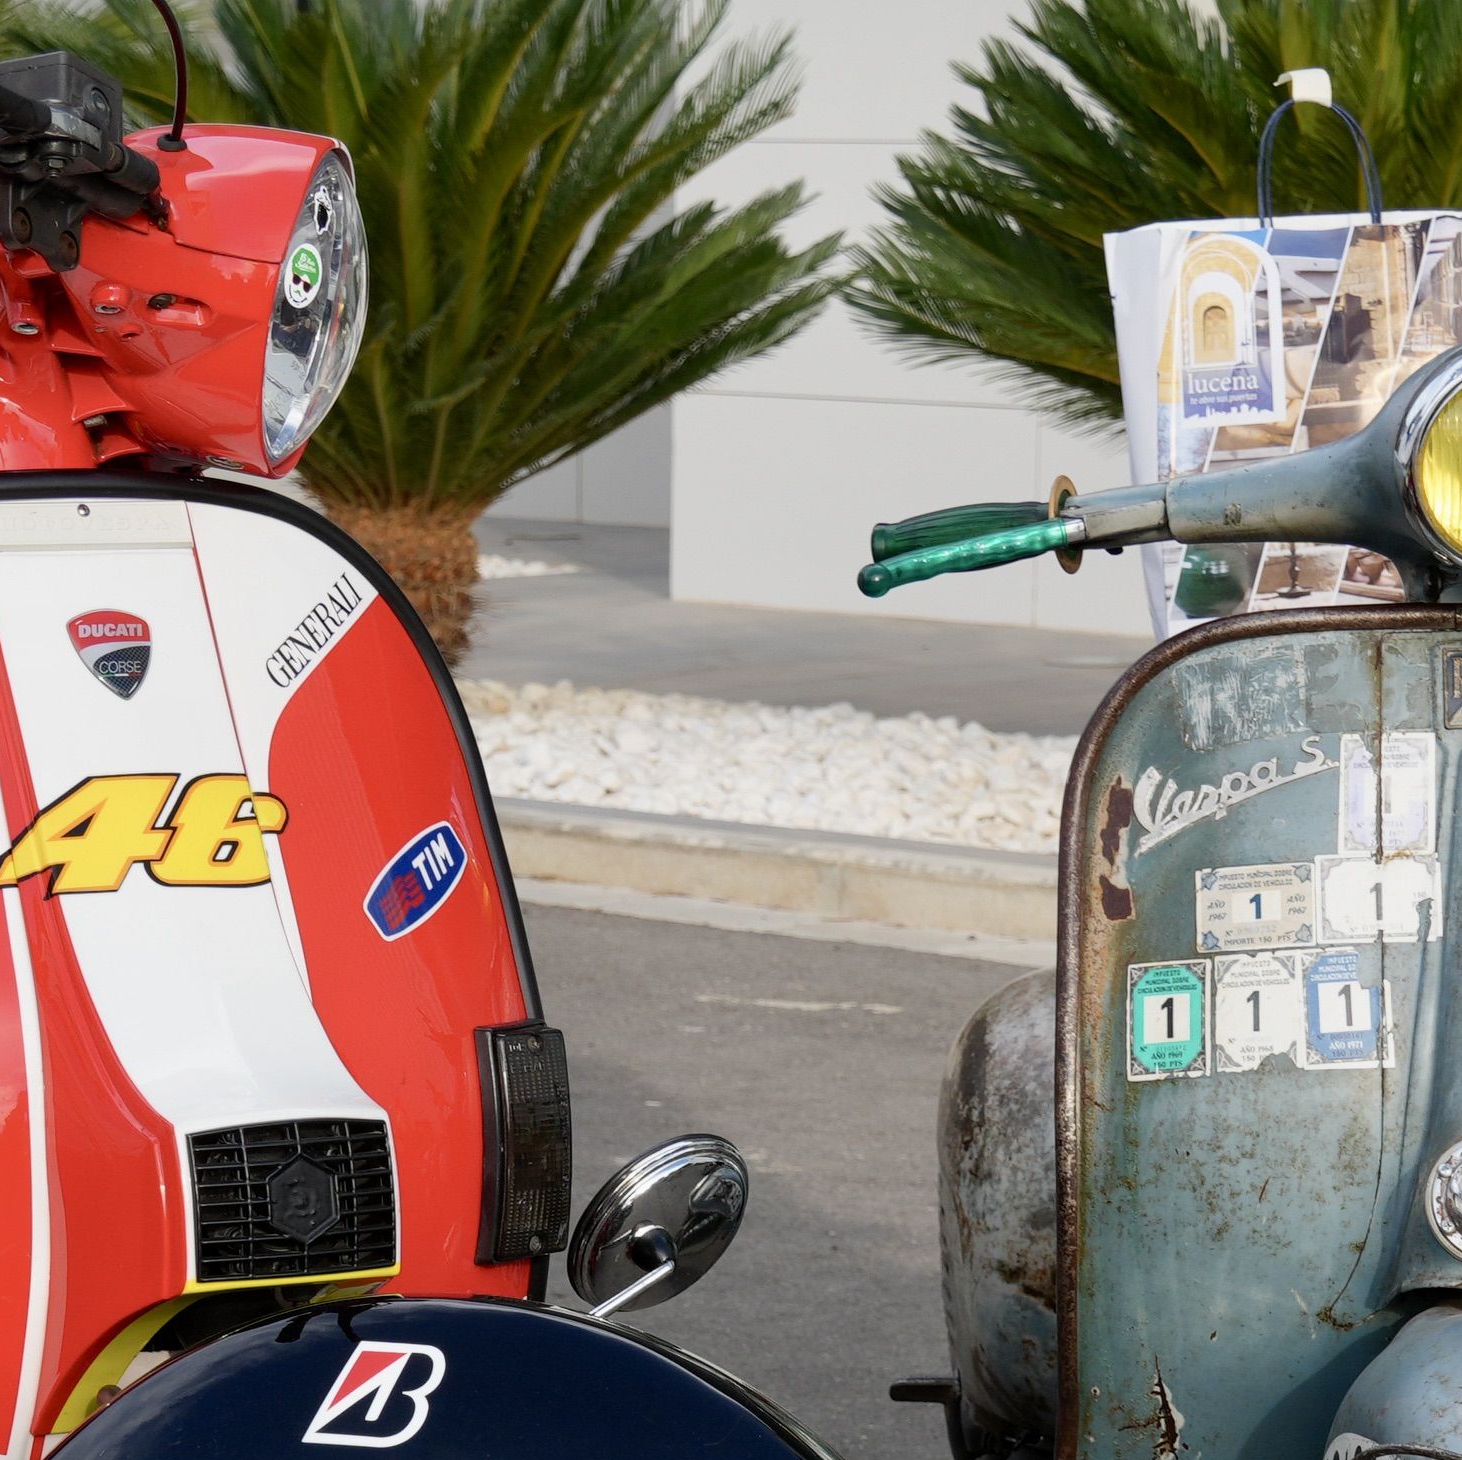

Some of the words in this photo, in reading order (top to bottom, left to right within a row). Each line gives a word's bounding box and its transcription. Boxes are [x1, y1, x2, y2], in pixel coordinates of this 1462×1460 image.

[1187, 373, 1259, 394] lucena
[77, 623, 143, 638] DUCATI
[263, 572, 363, 689] GENERALI
[99, 660, 141, 674] CORSE
[1132, 757, 1283, 855] Vespa
[411, 830, 455, 892] TIM
[1249, 893, 1262, 920] 1
[1370, 882, 1383, 921] 1
[1161, 997, 1174, 1038] 1
[1246, 990, 1260, 1032] 1
[1338, 984, 1353, 1027] 1
